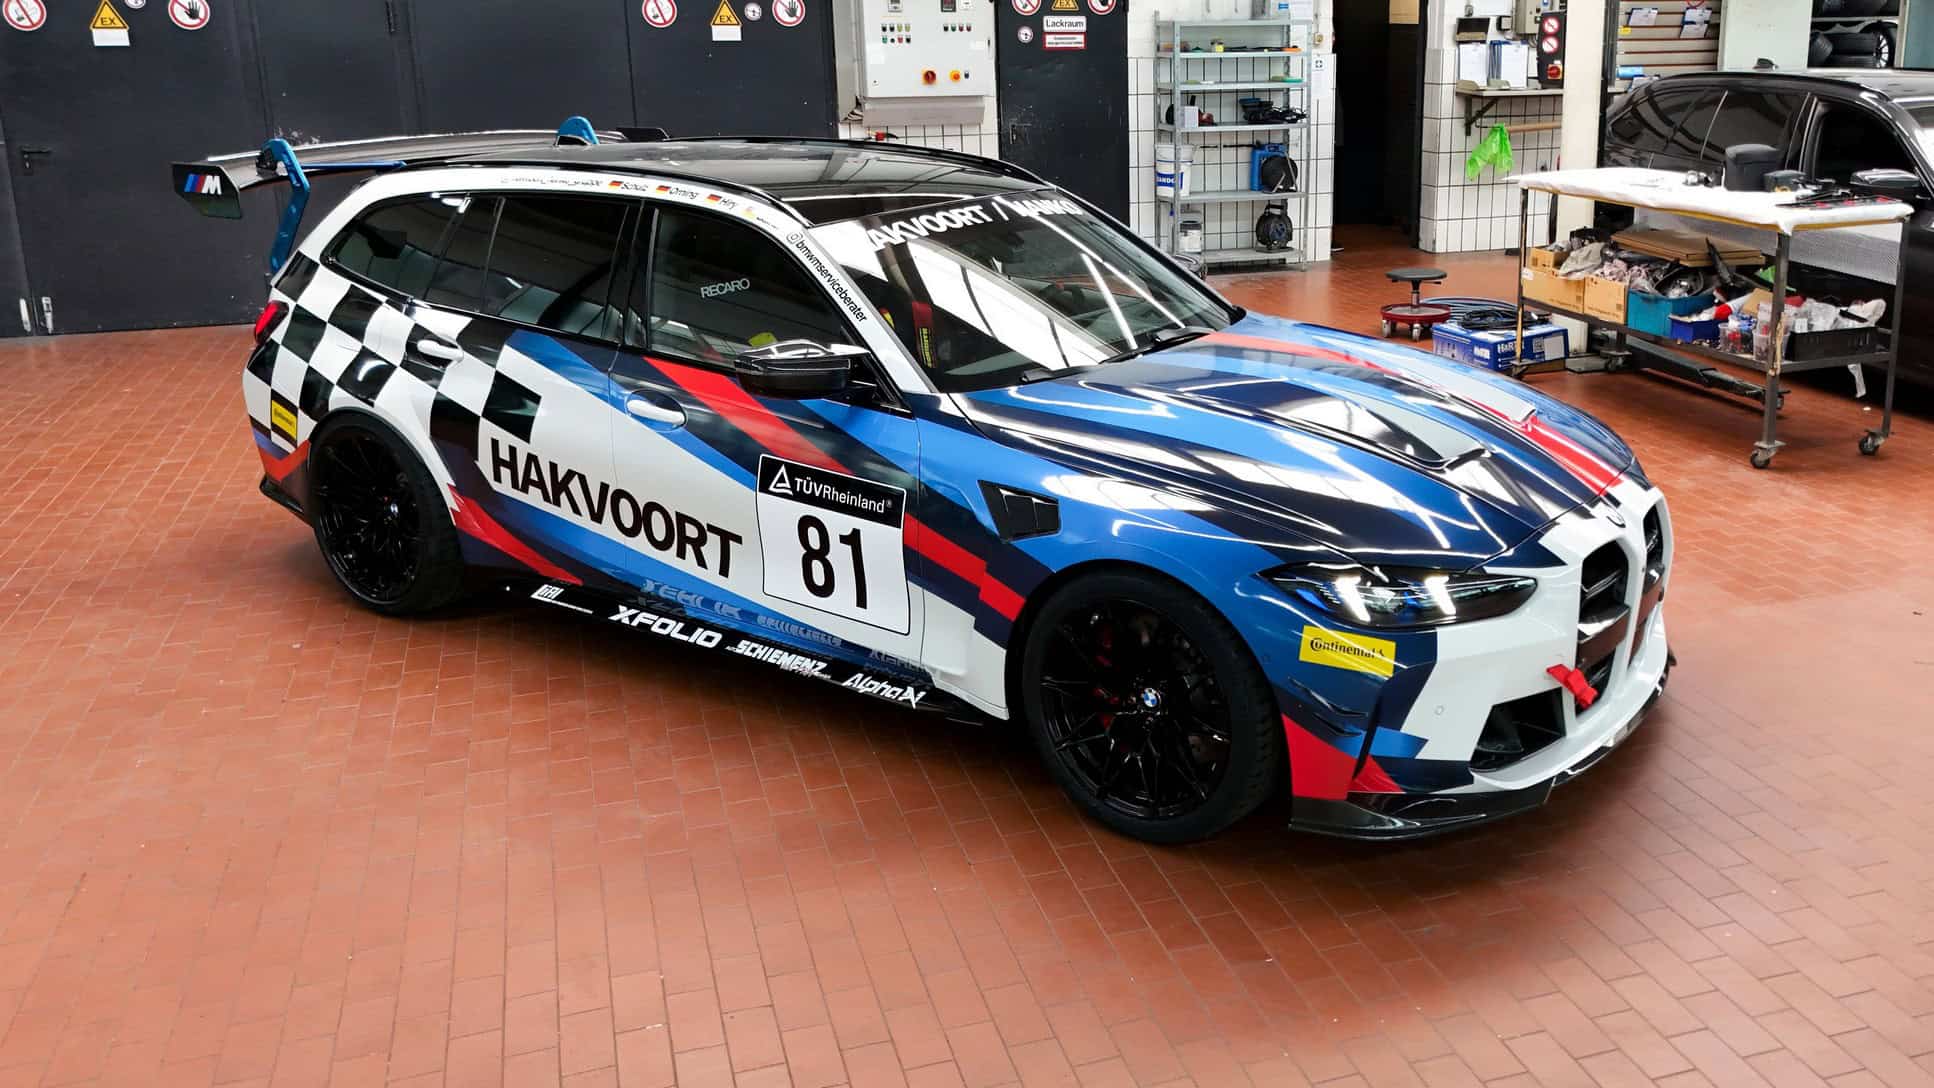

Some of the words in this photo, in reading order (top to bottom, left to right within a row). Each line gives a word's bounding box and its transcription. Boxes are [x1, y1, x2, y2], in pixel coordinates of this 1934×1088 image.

[100, 17, 117, 26] EX
[719, 15, 733, 23] EX
[1046, 19, 1084, 28] Lackraum
[700, 278, 750, 298] RECARO
[491, 438, 742, 578] HAKVOORT
[797, 515, 868, 610] 81
[608, 604, 723, 648] XFOLIO
[1309, 637, 1376, 659] Continental
